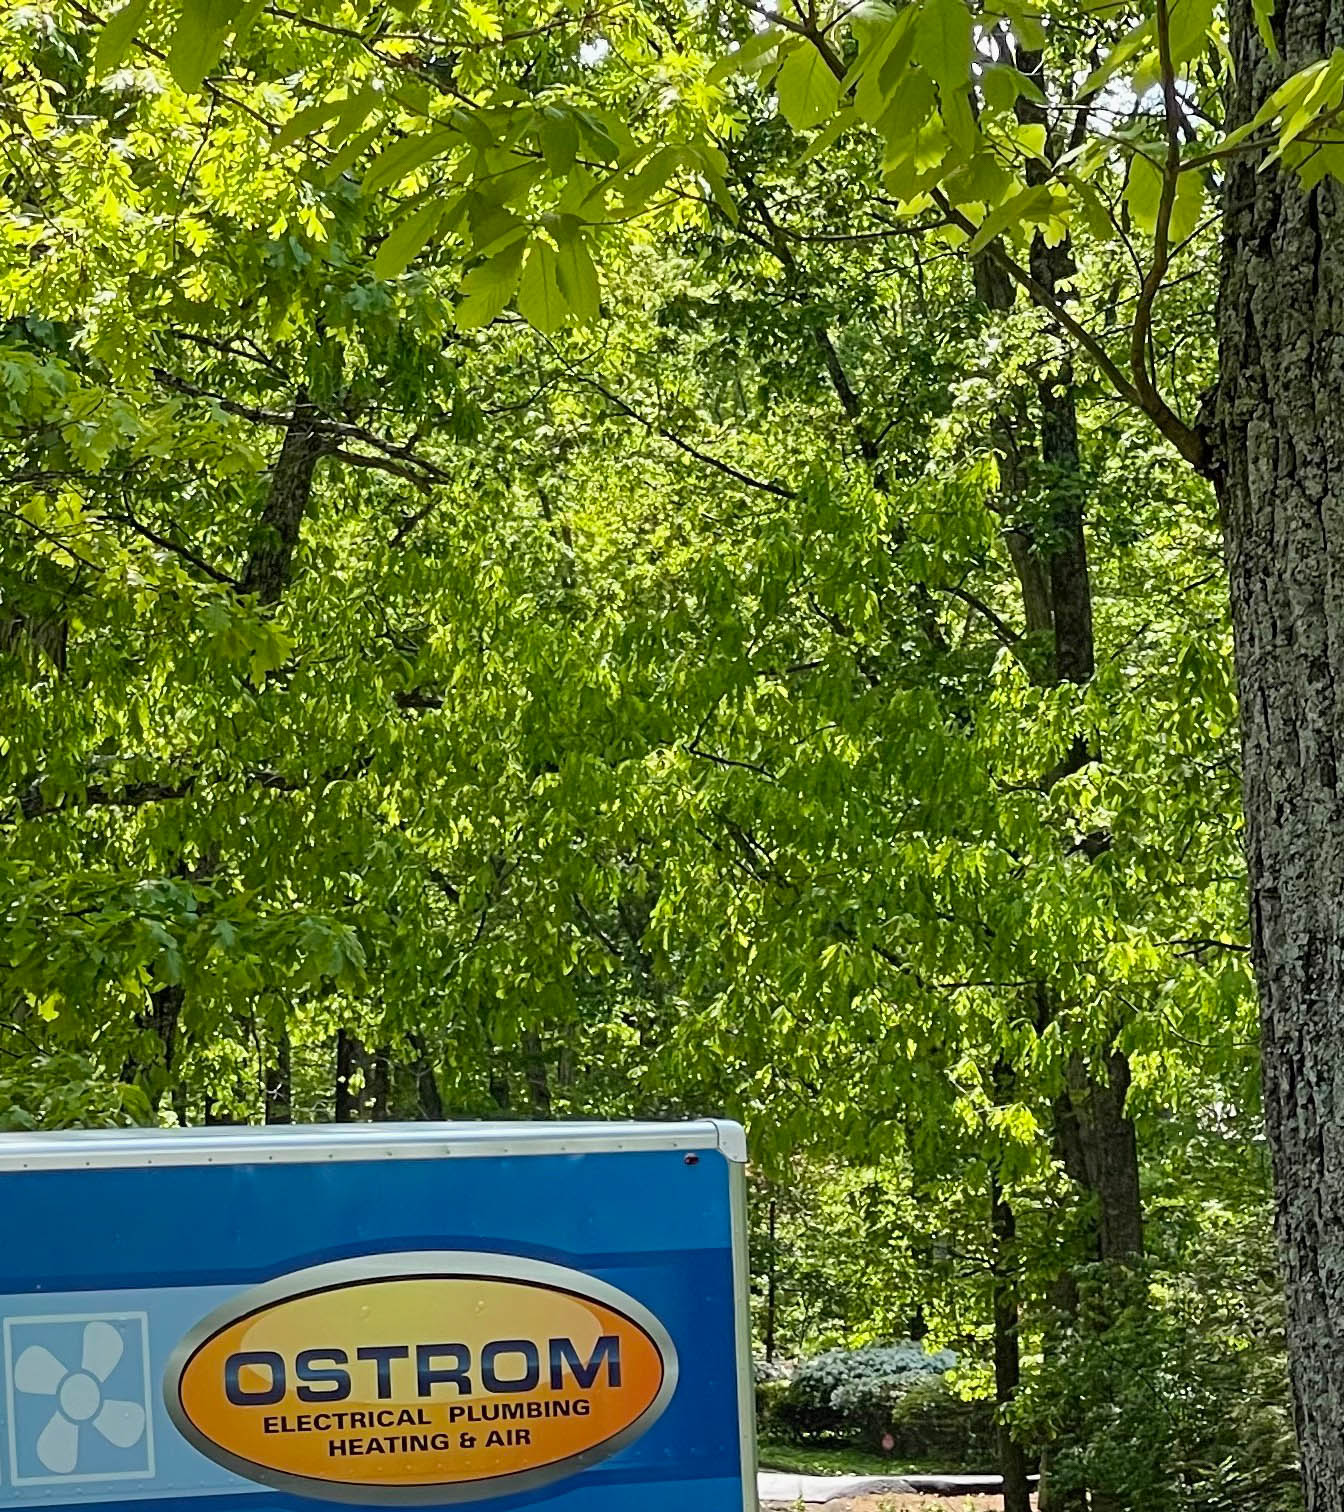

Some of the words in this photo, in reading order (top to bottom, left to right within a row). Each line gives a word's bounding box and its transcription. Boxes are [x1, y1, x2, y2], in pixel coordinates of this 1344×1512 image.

[224, 1336, 622, 1406] OSTROM
[263, 1409, 432, 1434] ELECTRICAL
[449, 1399, 591, 1423] PLUMBING
[328, 1432, 450, 1457] HEATING
[459, 1432, 477, 1449] &
[485, 1428, 531, 1448] AIR
